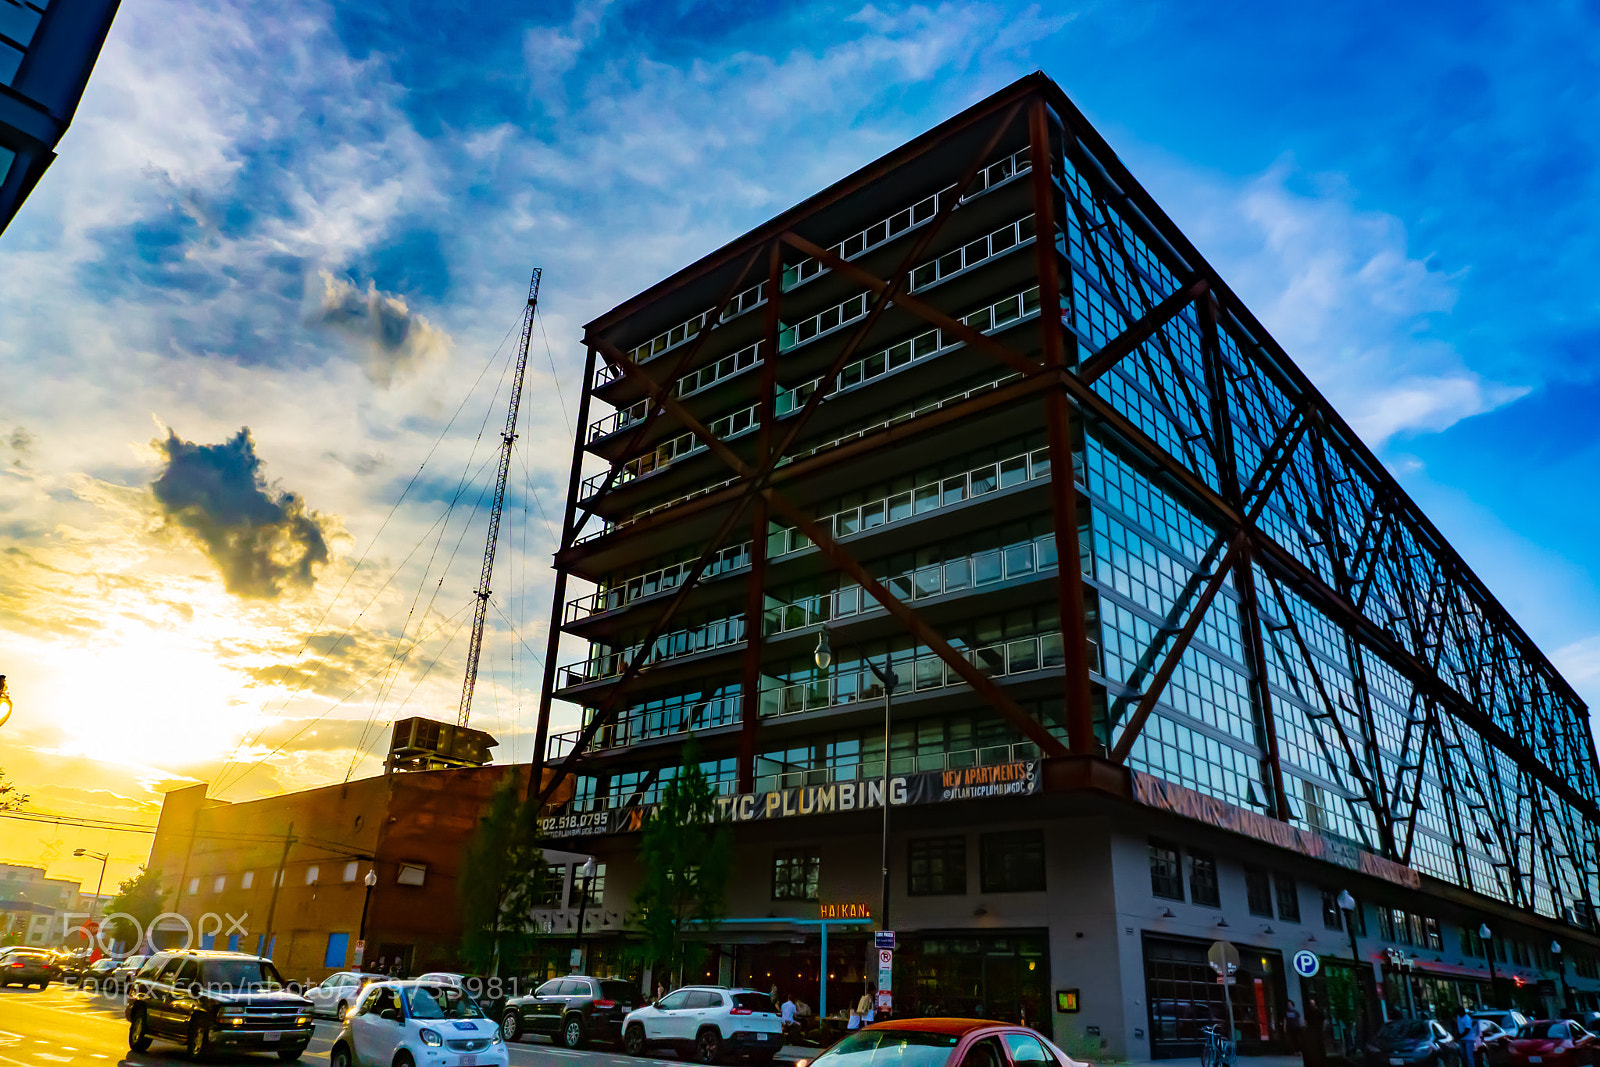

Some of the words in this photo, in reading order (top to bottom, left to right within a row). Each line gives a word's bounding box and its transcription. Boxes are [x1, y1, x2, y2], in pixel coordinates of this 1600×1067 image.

[942, 770, 961, 787] NEW
[965, 763, 1025, 784] APARTMENTS
[649, 795, 755, 826] AANTIC
[766, 777, 907, 818] PLUMBING
